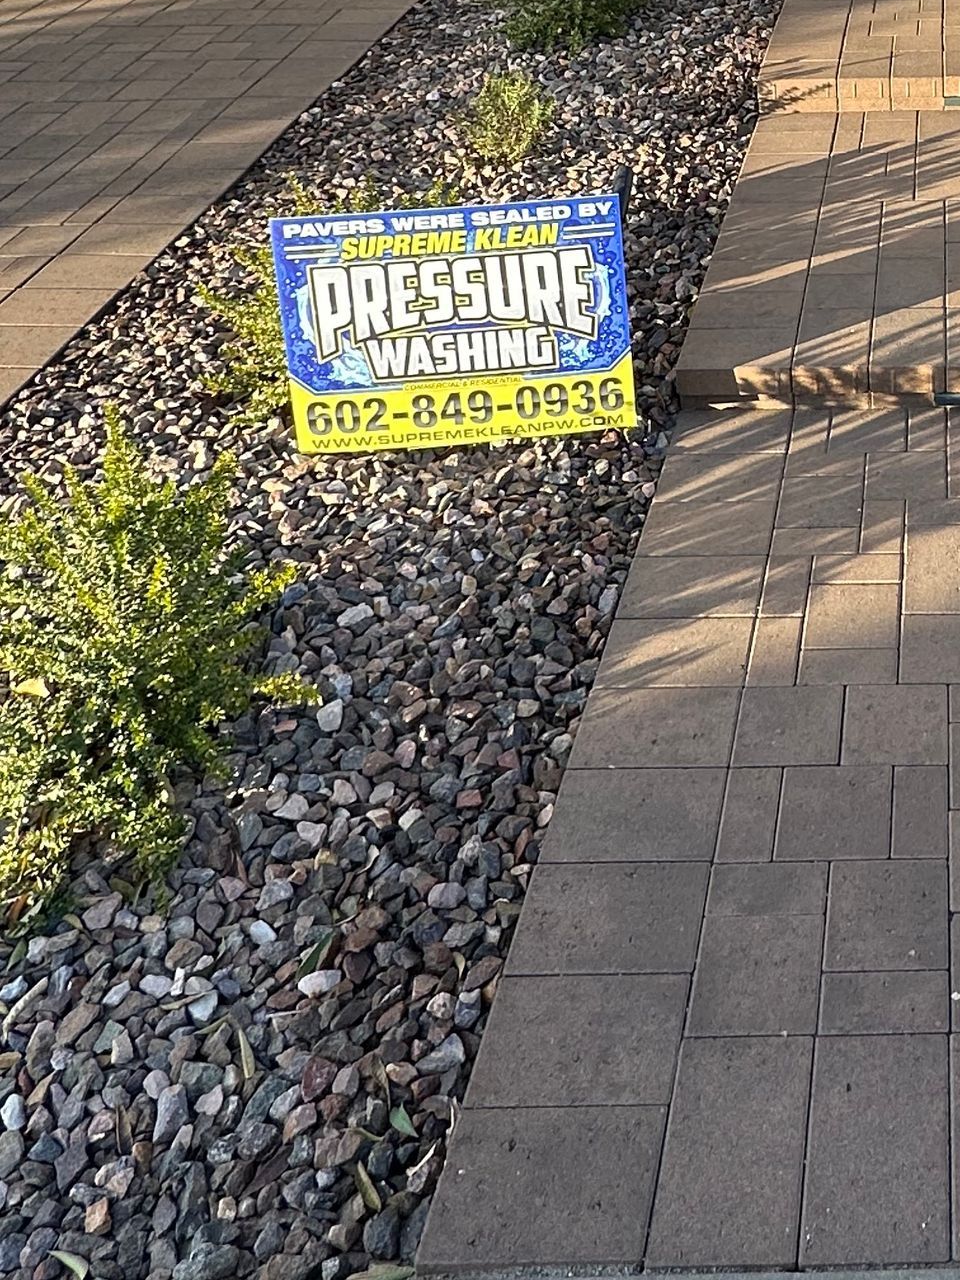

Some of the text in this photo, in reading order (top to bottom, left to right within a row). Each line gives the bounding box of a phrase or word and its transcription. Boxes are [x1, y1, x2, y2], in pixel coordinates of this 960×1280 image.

[283, 201, 613, 238] PAVERS WERE SEALED BY
[340, 223, 559, 260] SUPREME KLEAN
[309, 247, 597, 361] PRESSURE
[365, 326, 557, 378] WASHING
[307, 376, 625, 436] 602-849-0936
[312, 414, 625, 449] WWW.SUPREMEKLEANPW.COM
